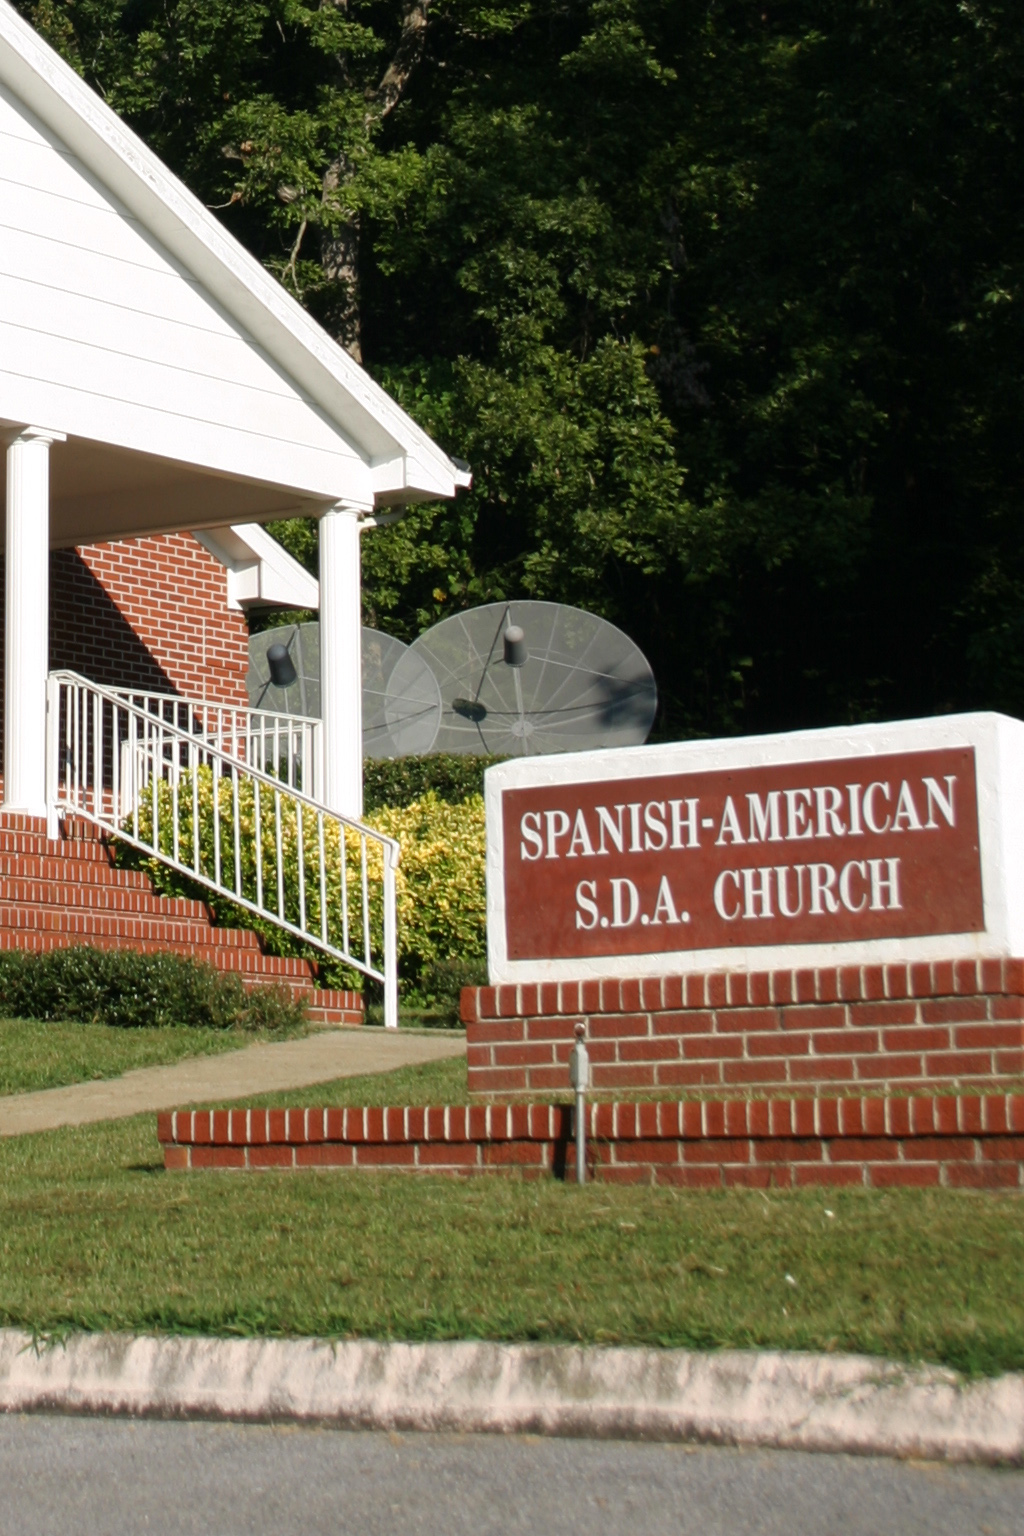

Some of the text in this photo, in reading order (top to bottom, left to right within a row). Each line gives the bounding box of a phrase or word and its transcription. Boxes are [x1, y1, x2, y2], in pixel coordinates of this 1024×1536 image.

[520, 775, 957, 861] SPANISH-AMERICAN
[576, 858, 903, 930] S.D.A. CHURCH
